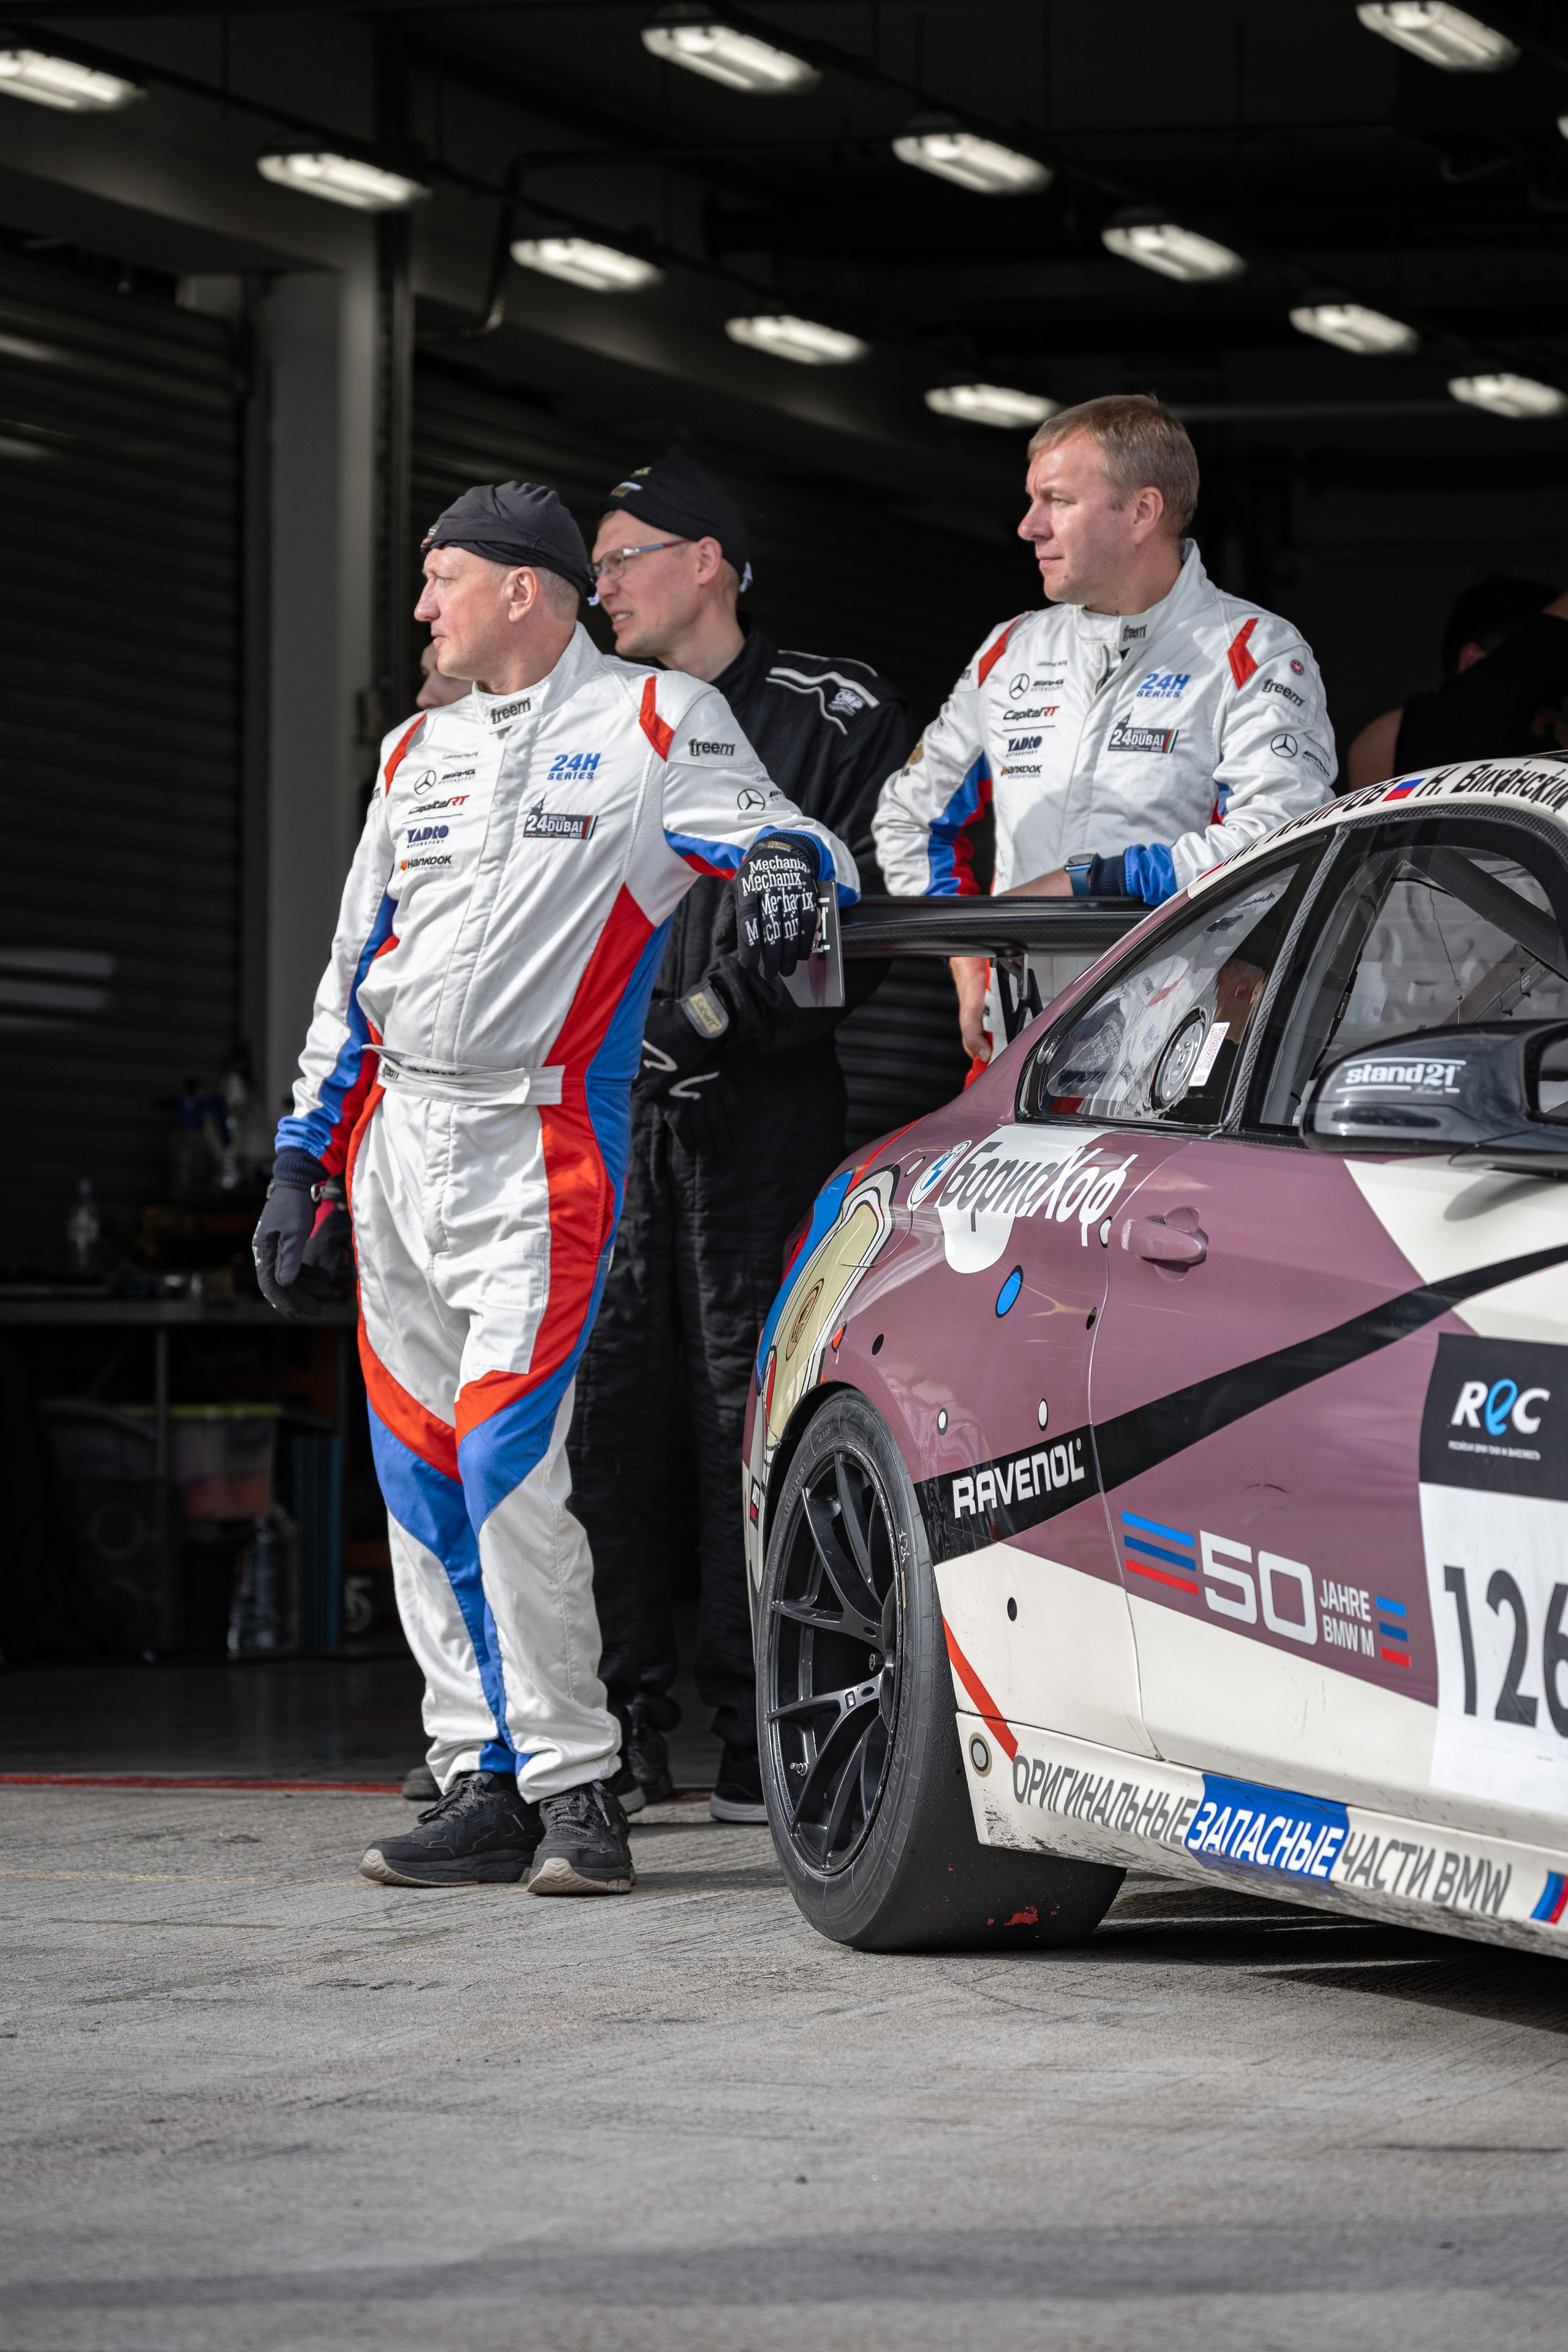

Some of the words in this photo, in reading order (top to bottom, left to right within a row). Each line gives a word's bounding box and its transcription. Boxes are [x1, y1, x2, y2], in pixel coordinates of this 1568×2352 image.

[1140, 673, 1191, 690] 24H
[1262, 678, 1305, 707] freem
[491, 698, 531, 724] freem
[688, 738, 735, 756] freem
[1132, 734, 1164, 747] DUBAI
[550, 753, 601, 771] 24H
[526, 815, 549, 832] 24
[547, 820, 584, 832] DUBAI
[1345, 1063, 1455, 1087] stand21
[1200, 1530, 1318, 1646] 50
[1320, 1578, 1371, 1623] JAHRE
[1323, 1617, 1359, 1653] BMW
[1361, 1629, 1376, 1657] M
[1444, 1565, 1568, 1739] 126
[1012, 1754, 1199, 1844] ОРИГИНАЛЬНЫЕ
[1186, 1801, 1346, 1880] ЗАПАСНЫЕ
[1341, 1830, 1437, 1898] ЧАСТИ
[1433, 1847, 1513, 1914] BMW
